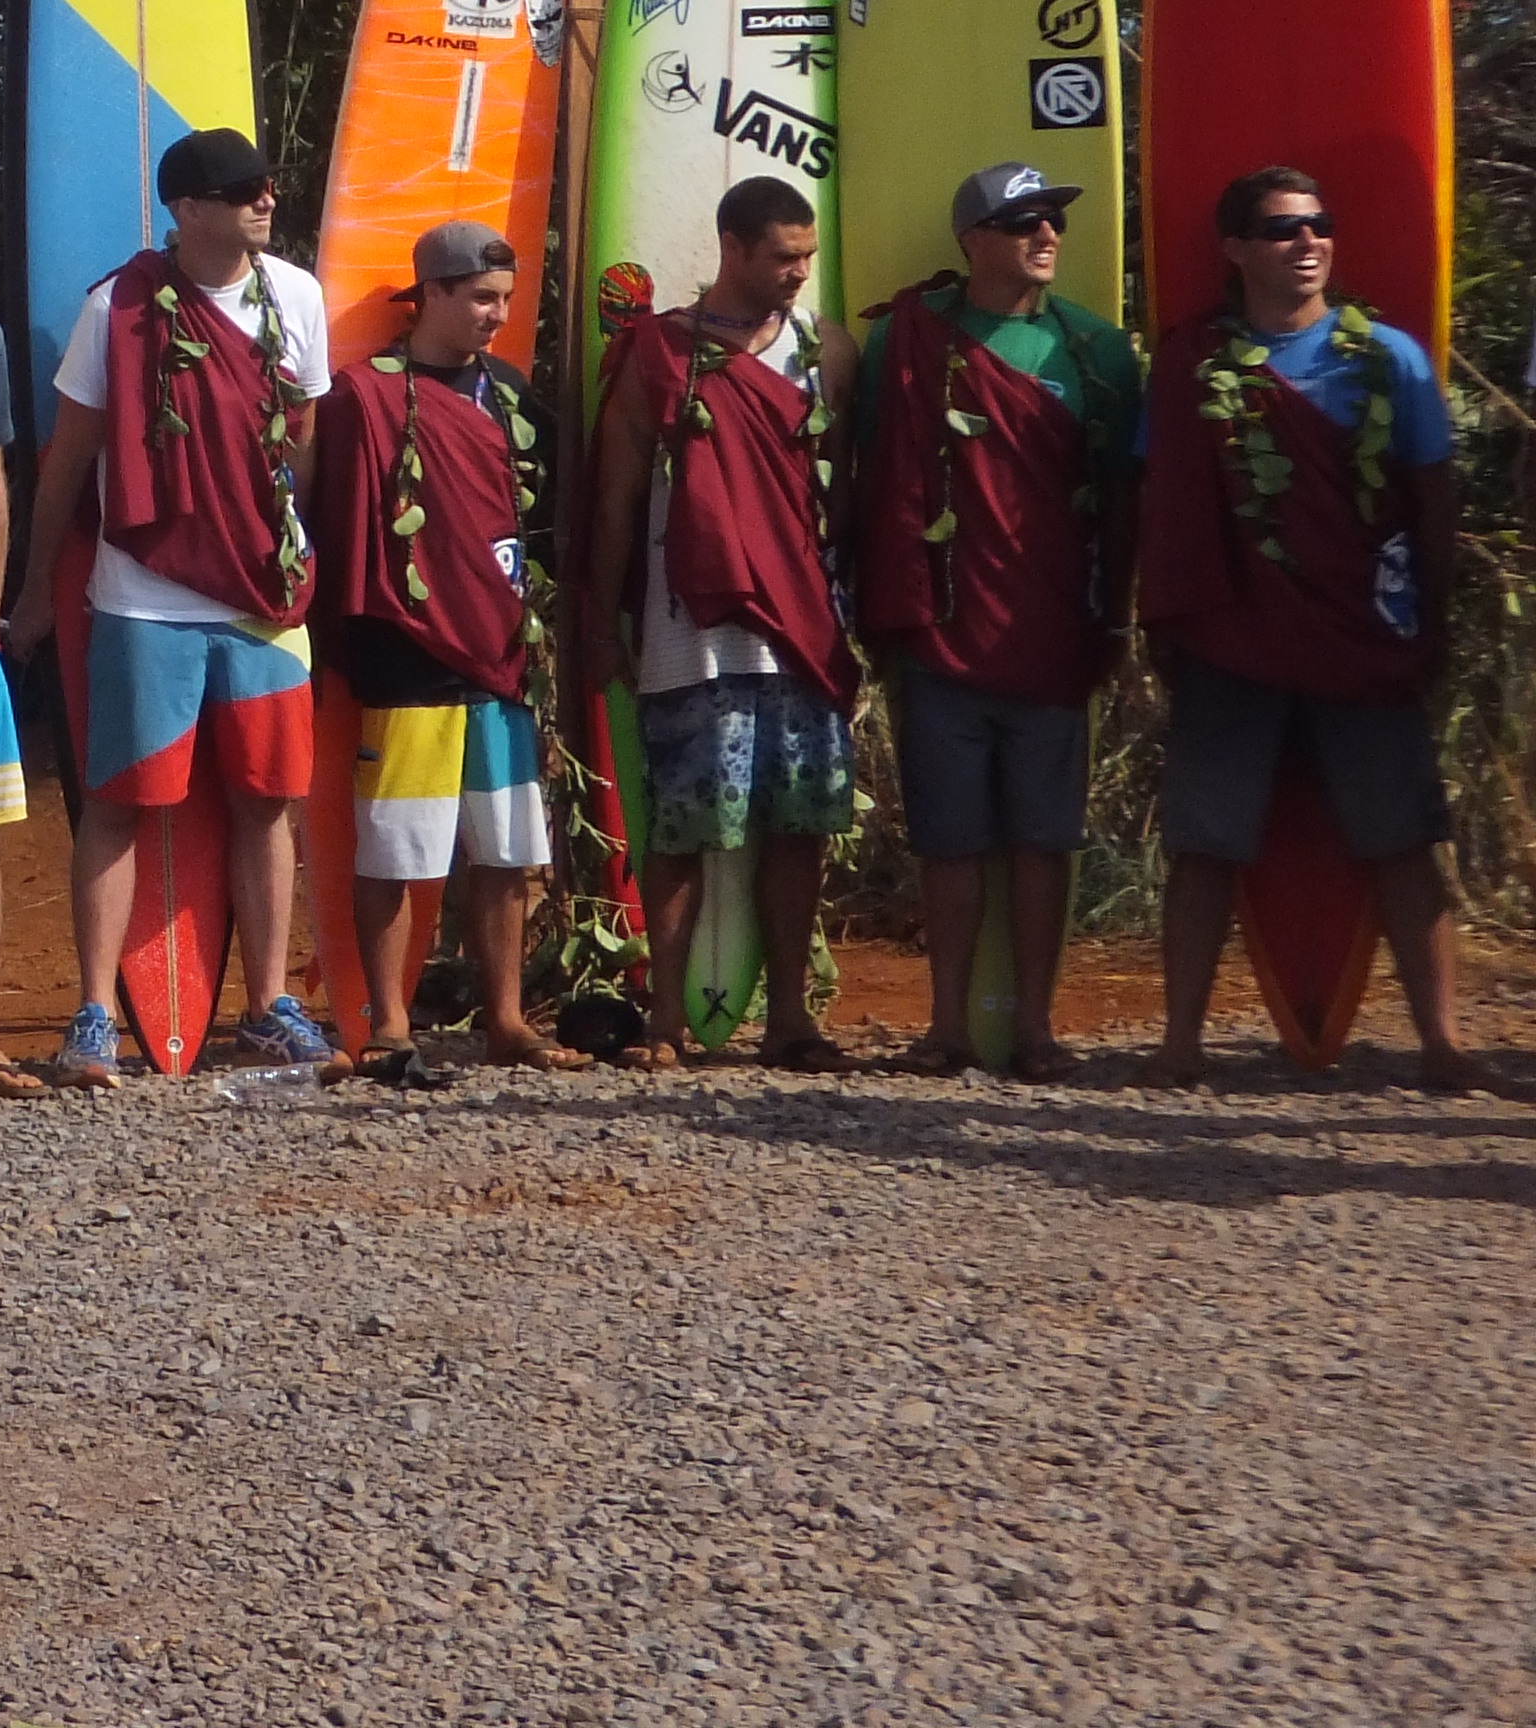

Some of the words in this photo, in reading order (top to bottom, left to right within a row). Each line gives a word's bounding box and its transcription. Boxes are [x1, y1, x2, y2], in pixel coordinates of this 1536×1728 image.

[747, 14, 832, 30] DAKINE
[386, 32, 479, 52] DAKINE
[713, 76, 839, 180] VANS
